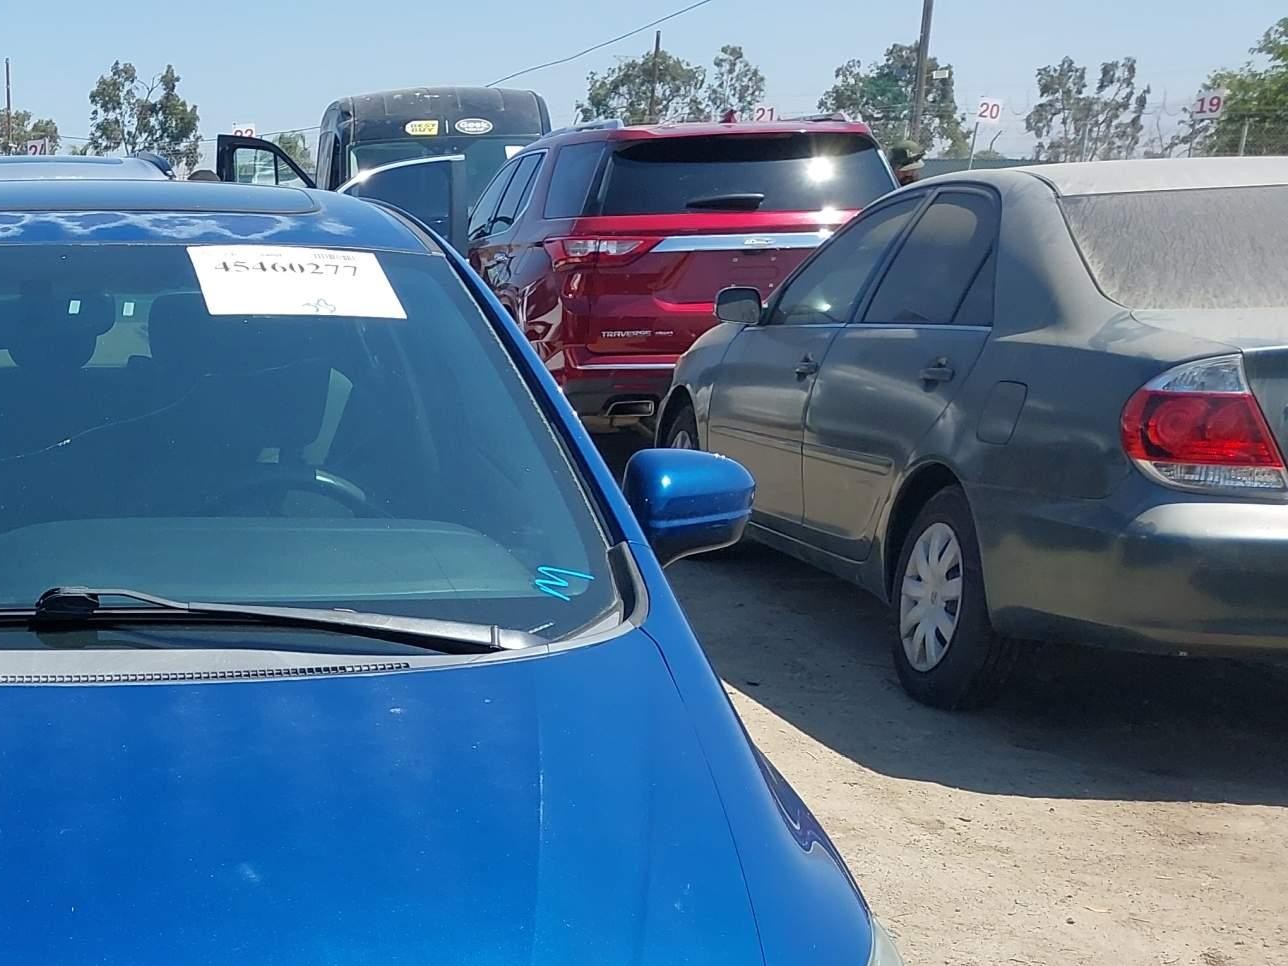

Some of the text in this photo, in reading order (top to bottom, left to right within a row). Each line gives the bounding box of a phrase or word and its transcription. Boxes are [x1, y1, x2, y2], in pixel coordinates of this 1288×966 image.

[978, 102, 1000, 119] 20
[1196, 96, 1222, 113] 19
[755, 107, 774, 121] 21
[213, 260, 358, 278] 45460277
